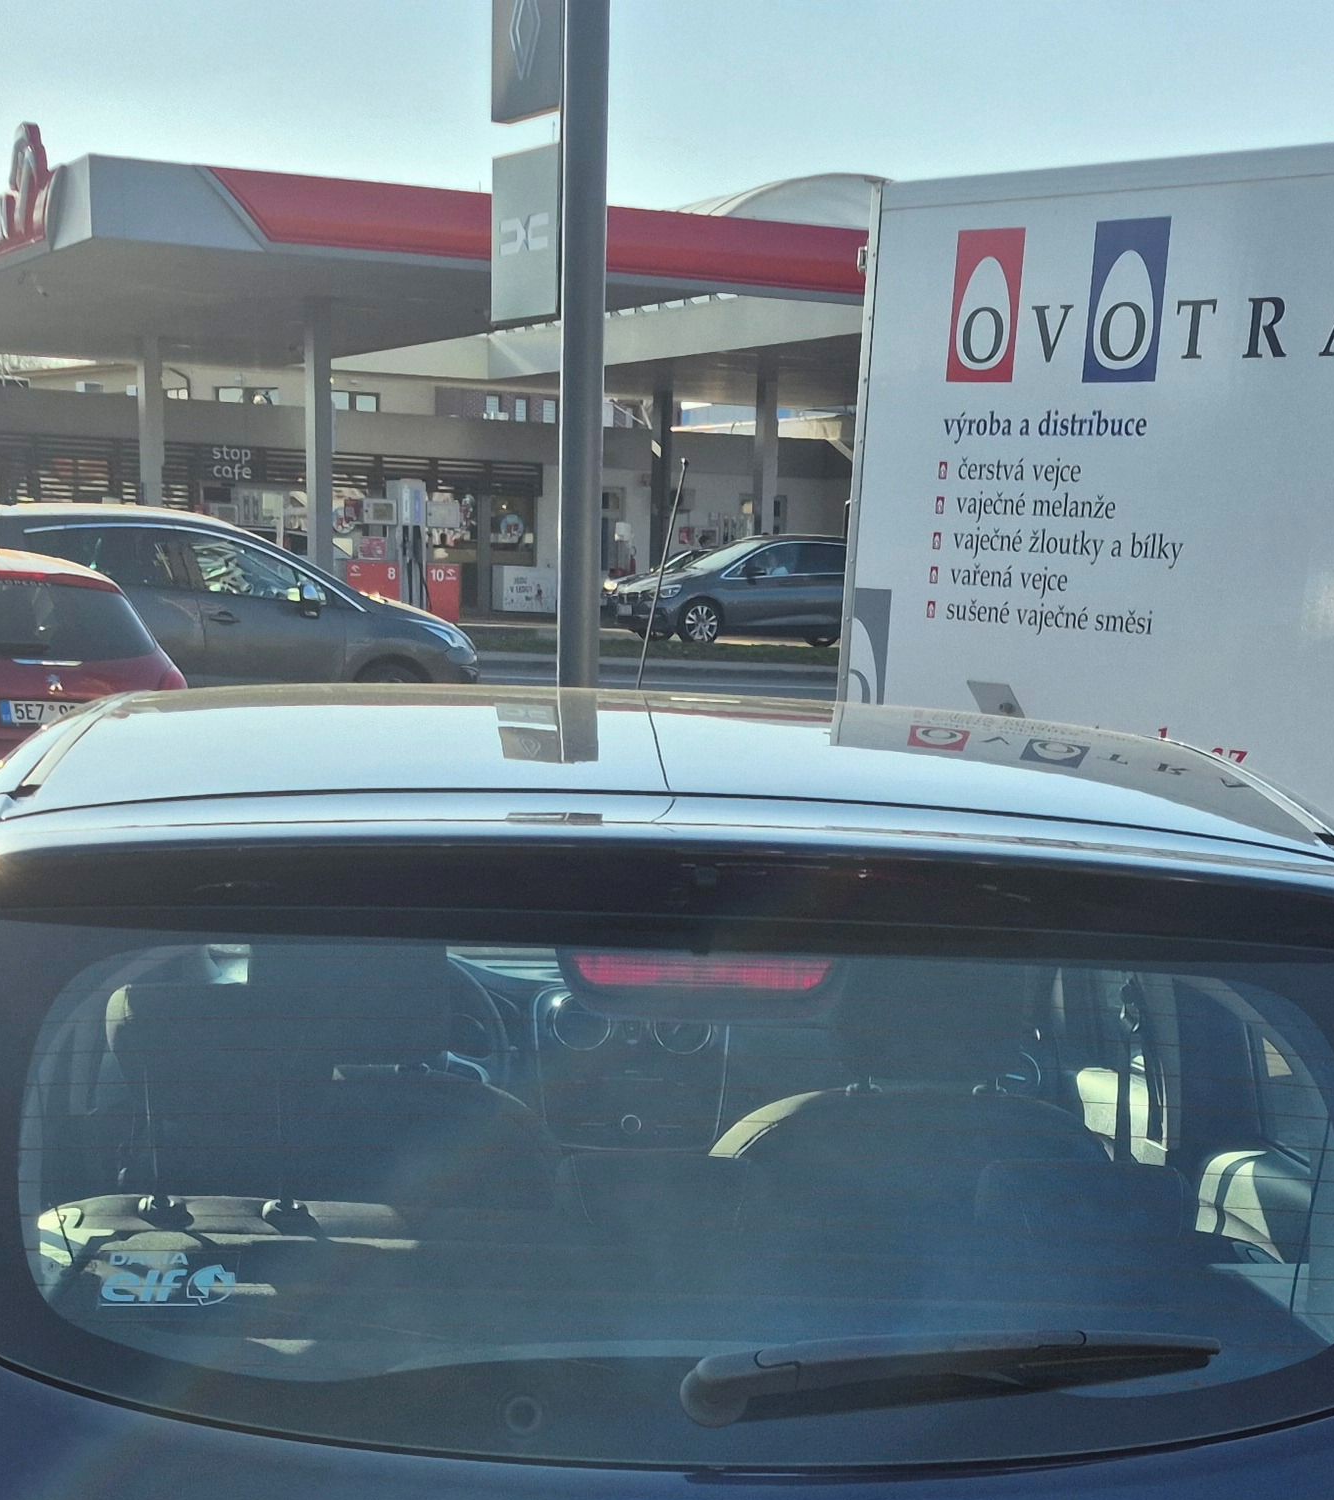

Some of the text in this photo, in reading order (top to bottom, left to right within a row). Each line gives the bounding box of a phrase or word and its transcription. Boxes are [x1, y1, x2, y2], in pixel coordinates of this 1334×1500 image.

[944, 410, 1148, 445] výroba a distribuce
[212, 445, 252, 464] stop
[212, 464, 252, 480] cafe
[958, 456, 1082, 491] čerstvá vejce
[956, 491, 1116, 522] vaječné melanže
[953, 527, 1184, 570] vaječné žloutky a bílky
[387, 567, 396, 580] 8
[430, 568, 445, 582] 10
[950, 563, 1068, 599] vařená vejce
[946, 600, 1154, 636] sušené vaječné směsi
[109, 1251, 189, 1266] DAA
[101, 1268, 188, 1302] elf
